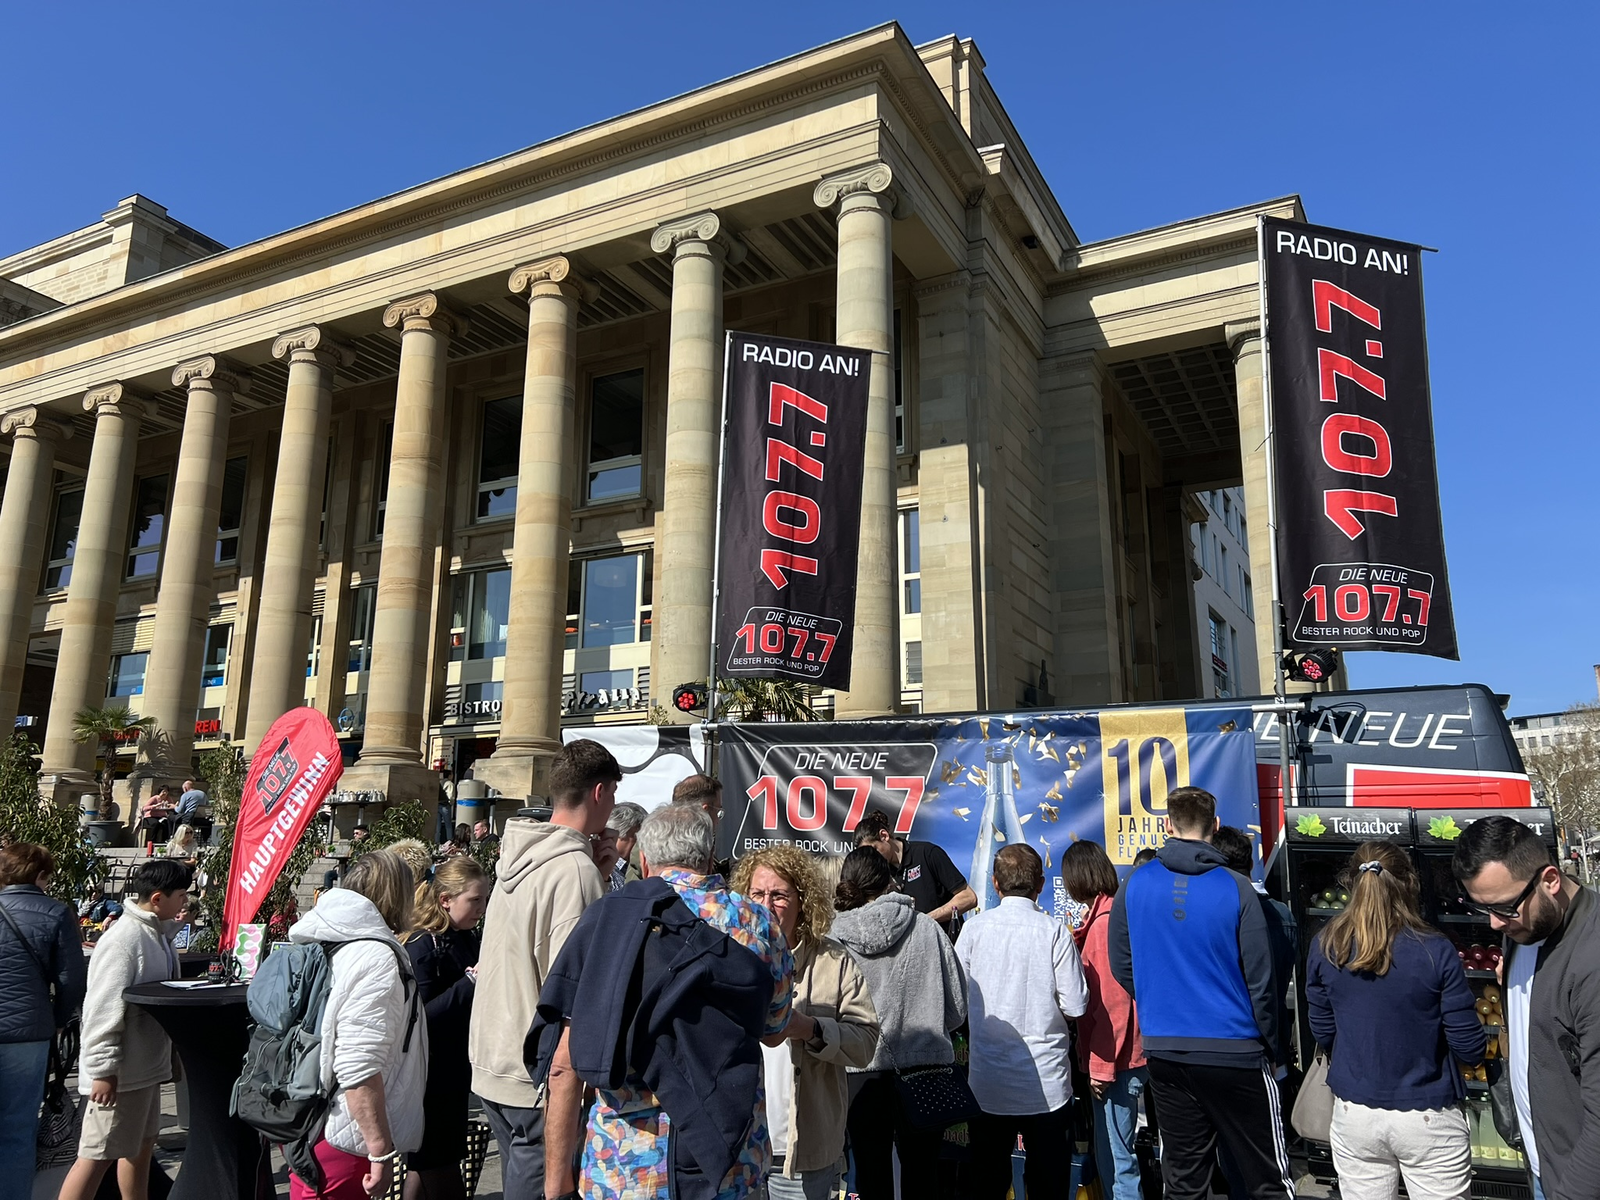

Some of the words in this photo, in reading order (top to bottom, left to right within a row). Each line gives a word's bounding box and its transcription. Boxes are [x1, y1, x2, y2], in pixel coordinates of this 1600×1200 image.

[1277, 230, 1357, 265] RADIO
[1364, 248, 1408, 275] AN!
[743, 343, 814, 370] RADIO
[819, 354, 859, 377] AN!
[1312, 279, 1399, 541] 107.7
[760, 381, 828, 591] 107.7
[1339, 568, 1367, 581] DIE
[1369, 569, 1408, 584] NEUE
[1303, 583, 1431, 626] 107.7
[765, 611, 786, 622] DIE
[787, 615, 818, 629] NEUE
[1302, 626, 1340, 636] BESTER
[1343, 626, 1373, 636] ROCK
[1376, 627, 1399, 636] UND
[1402, 629, 1421, 638] POP
[735, 623, 837, 663] 107.7
[733, 657, 762, 665] BESTER
[764, 657, 785, 666] ROCK
[786, 661, 803, 670] UND
[804, 664, 820, 672] POP
[450, 699, 501, 715] BISTRO
[194, 720, 220, 734] REN
[1309, 709, 1471, 750] NEUE
[259, 744, 295, 802] 107.7
[794, 752, 828, 770] DIE
[831, 752, 889, 770] NEUE
[1107, 736, 1178, 816] 10
[746, 775, 925, 833] 1077
[239, 751, 331, 895] HAUPTGEWINN
[1118, 817, 1165, 833] JAHR
[1329, 816, 1403, 835] Teinacher
[795, 840, 828, 853] ROCK
[833, 841, 856, 853] UN
[1118, 834, 1168, 846] GENUS
